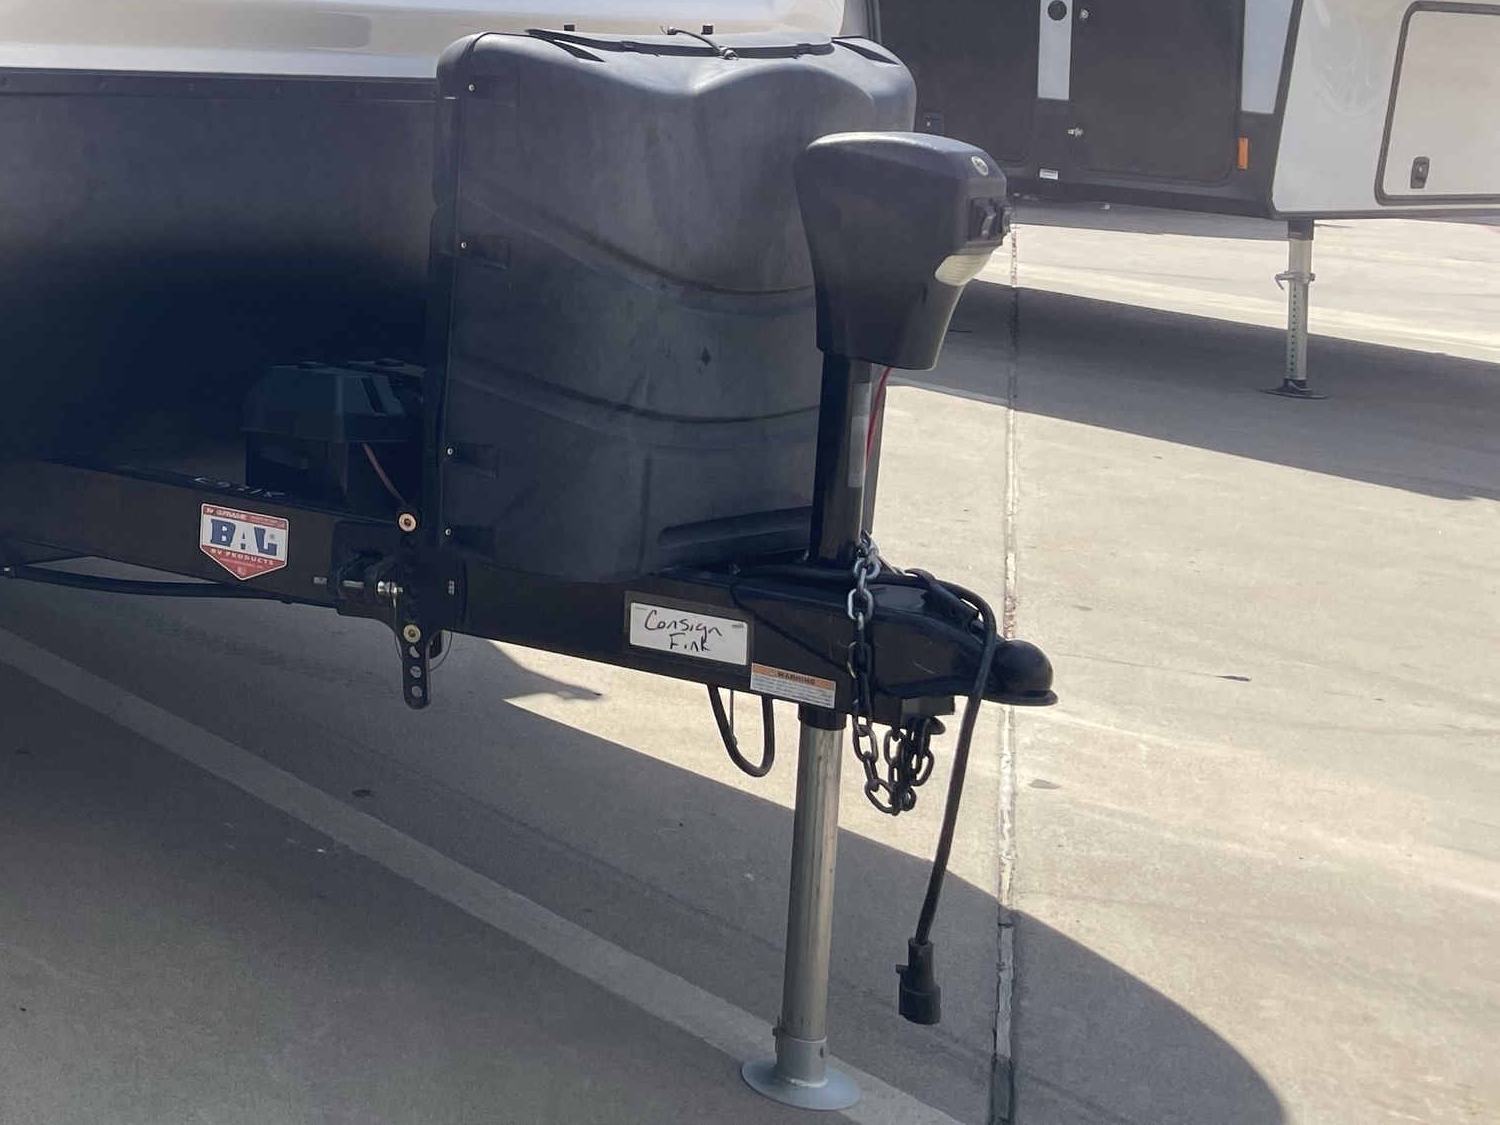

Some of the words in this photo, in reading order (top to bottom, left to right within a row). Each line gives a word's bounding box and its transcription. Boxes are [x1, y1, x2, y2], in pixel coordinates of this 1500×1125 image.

[210, 518, 278, 557] BAL
[225, 551, 274, 566] PRODUCTS
[644, 609, 723, 644] Consign
[777, 671, 816, 685] WARNING
